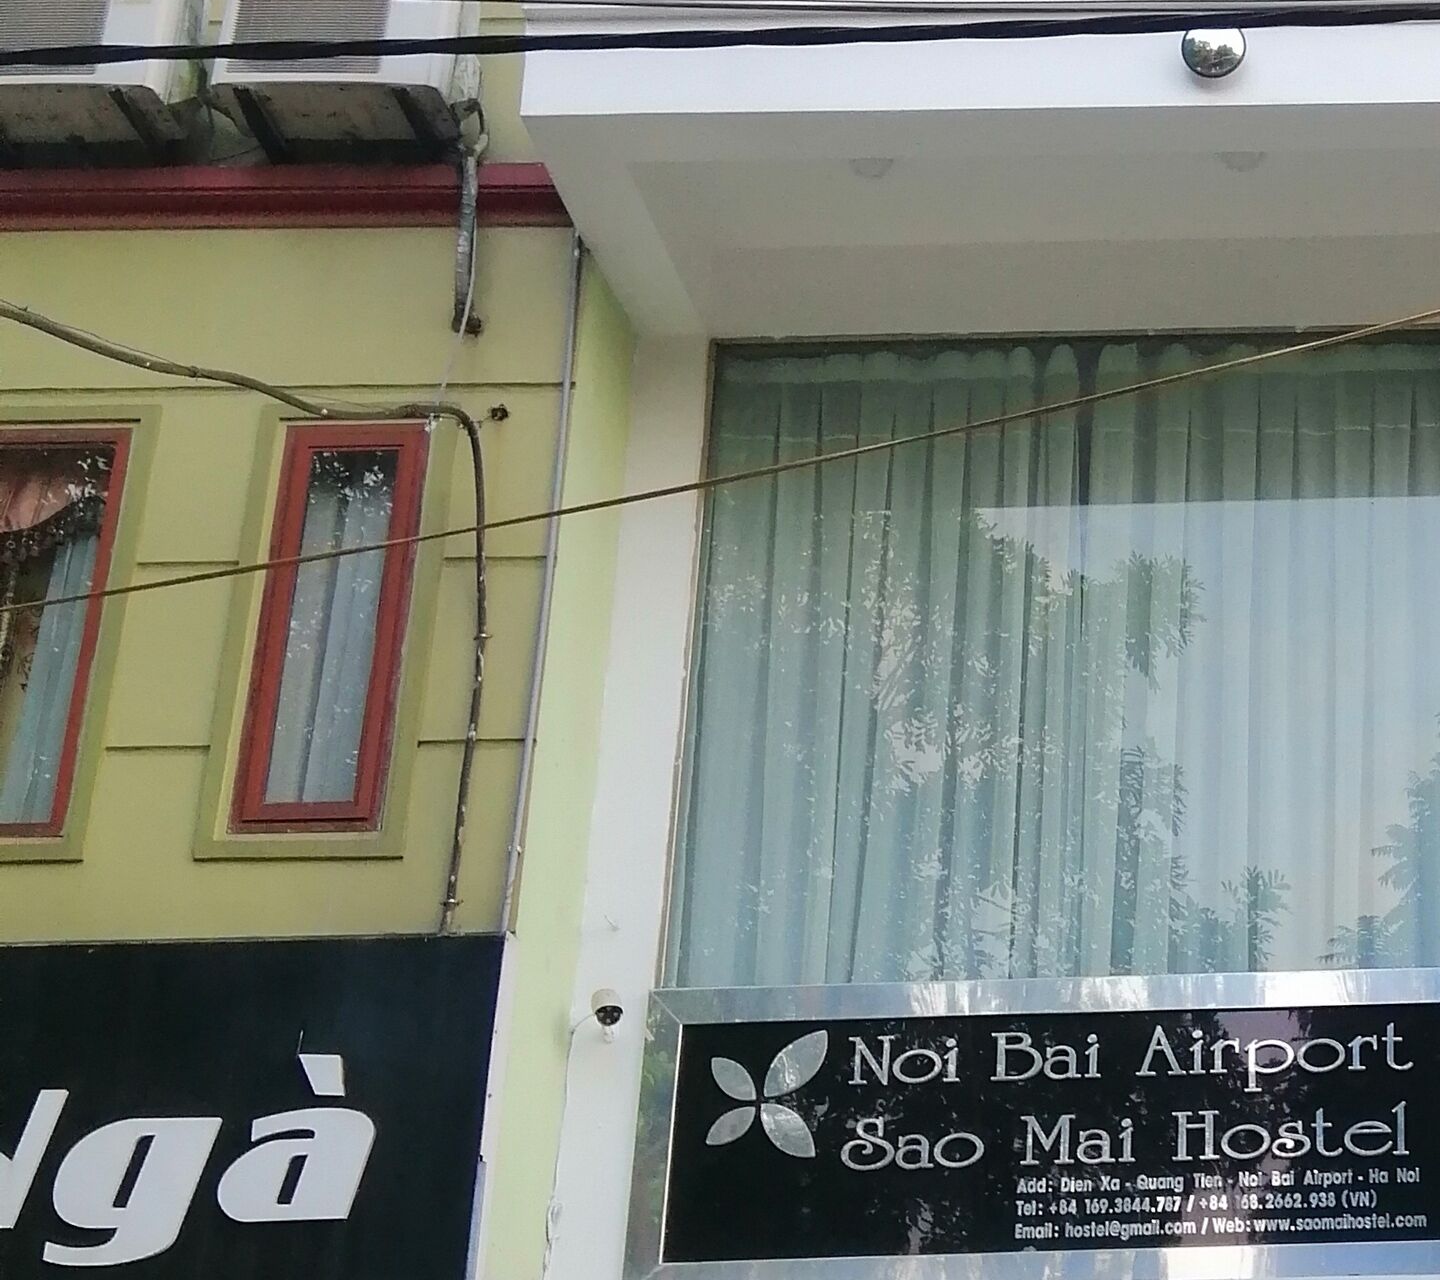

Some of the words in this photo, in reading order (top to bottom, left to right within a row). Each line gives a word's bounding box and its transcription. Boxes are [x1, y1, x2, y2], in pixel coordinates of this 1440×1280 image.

[848, 1035, 961, 1085] Noi
[991, 1032, 1103, 1080] Bai
[1135, 1022, 1414, 1092] Airport
[840, 1118, 985, 1171] Sao
[1019, 1114, 1135, 1166] Mai
[1170, 1100, 1410, 1162] Hostel
[1017, 1177, 1053, 1193] Add:
[1100, 1176, 1120, 1191] Xa
[1137, 1175, 1184, 1193] Quang
[1193, 1173, 1222, 1188] Tien
[1272, 1171, 1295, 1185] Bai
[1304, 1169, 1353, 1188] Airport
[1369, 1169, 1388, 1184] Ha
[1016, 1201, 1043, 1215] Tel:
[1050, 1200, 1077, 1214] +84
[1199, 1195, 1228, 1210] +84
[1342, 1189, 1377, 1208] (VN)
[1015, 1222, 1059, 1238] Email:
[1065, 1219, 1197, 1240] hostel@gmail.com
